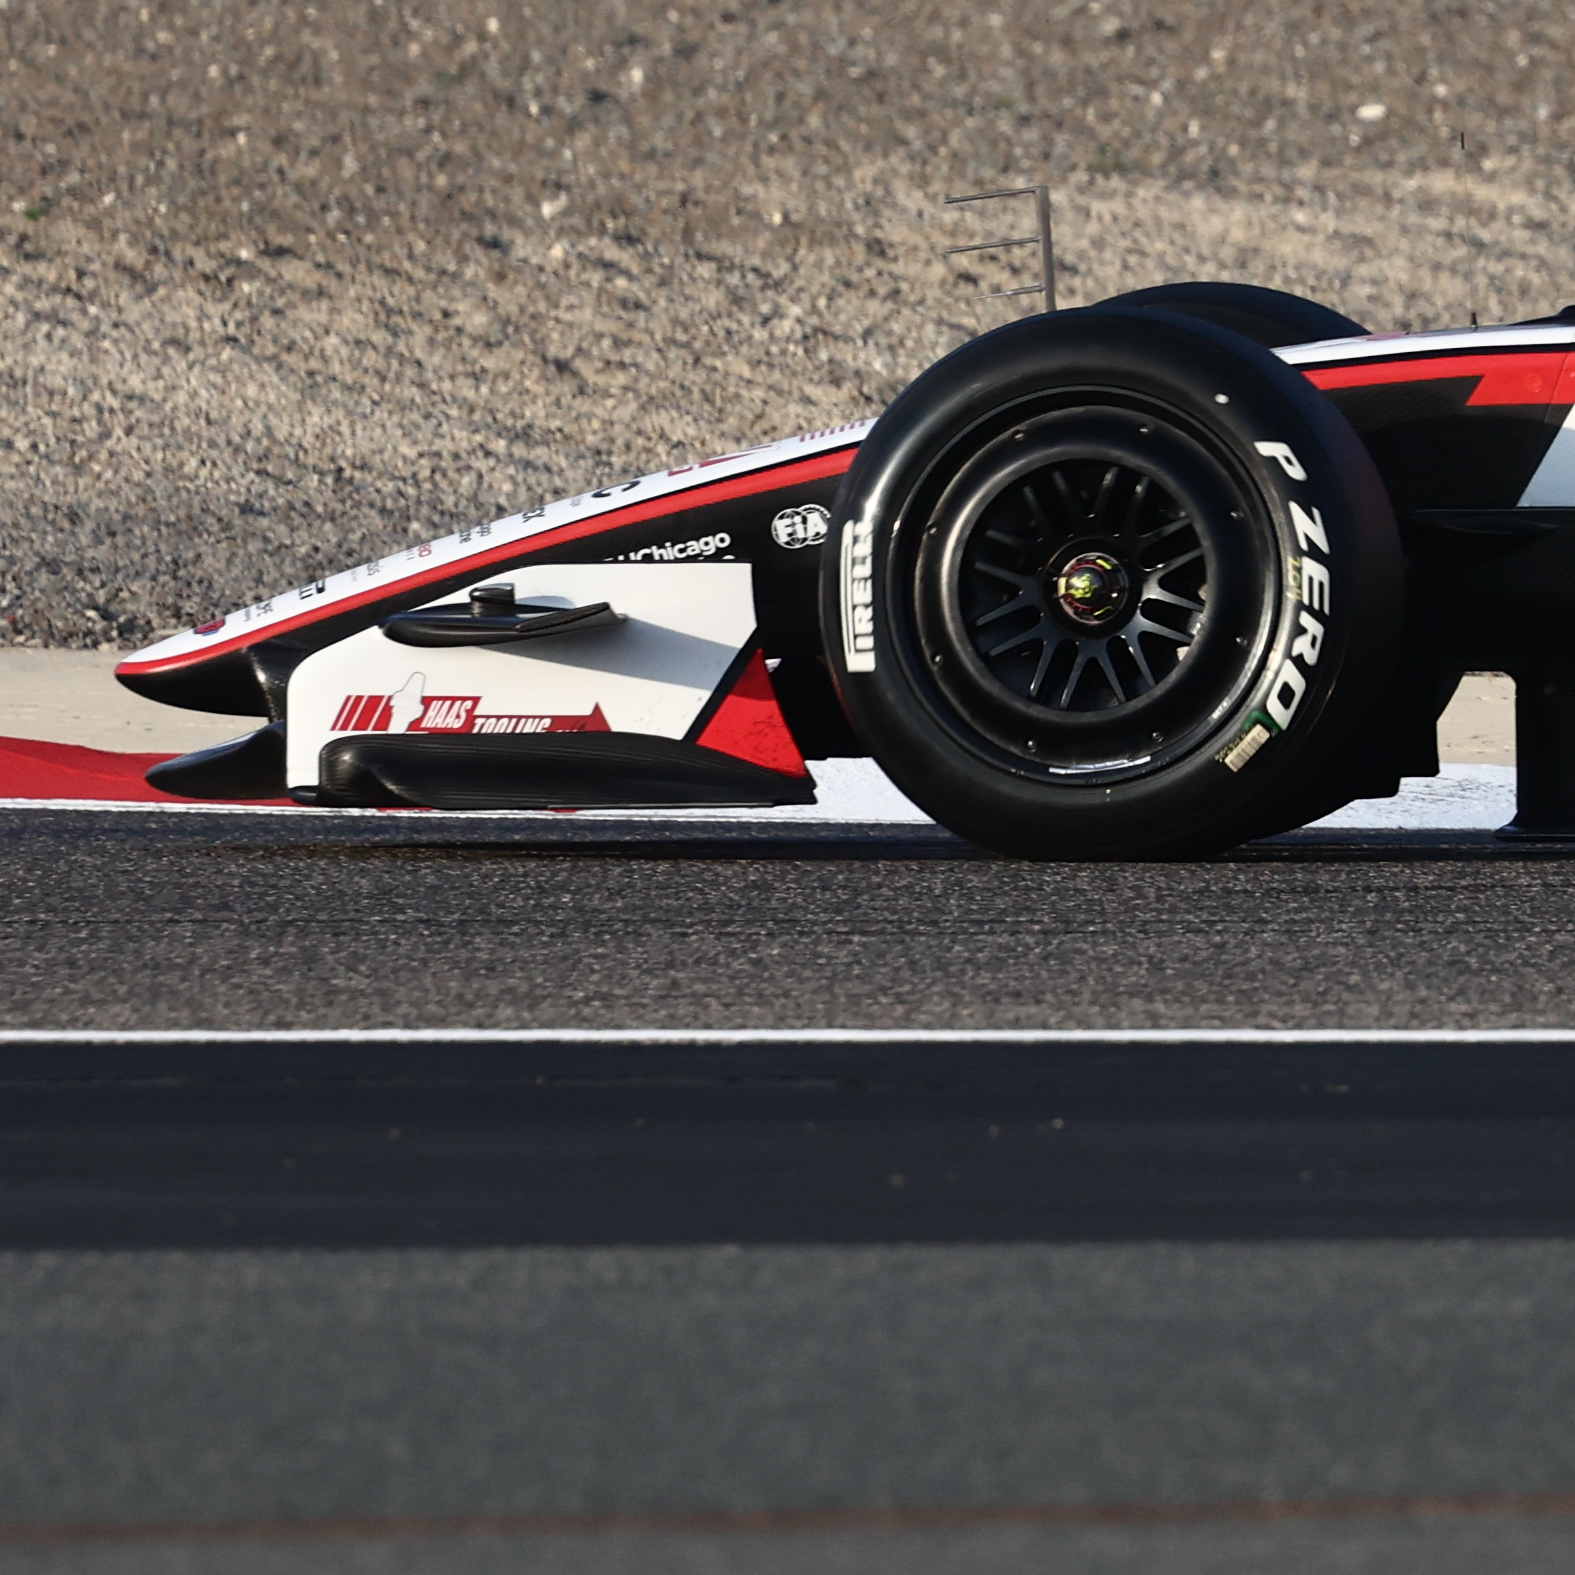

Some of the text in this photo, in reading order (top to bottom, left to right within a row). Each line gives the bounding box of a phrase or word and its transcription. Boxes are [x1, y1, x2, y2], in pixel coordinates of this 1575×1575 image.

[1253, 440, 1331, 731] P ZERO
[420, 700, 474, 729] HAAS
